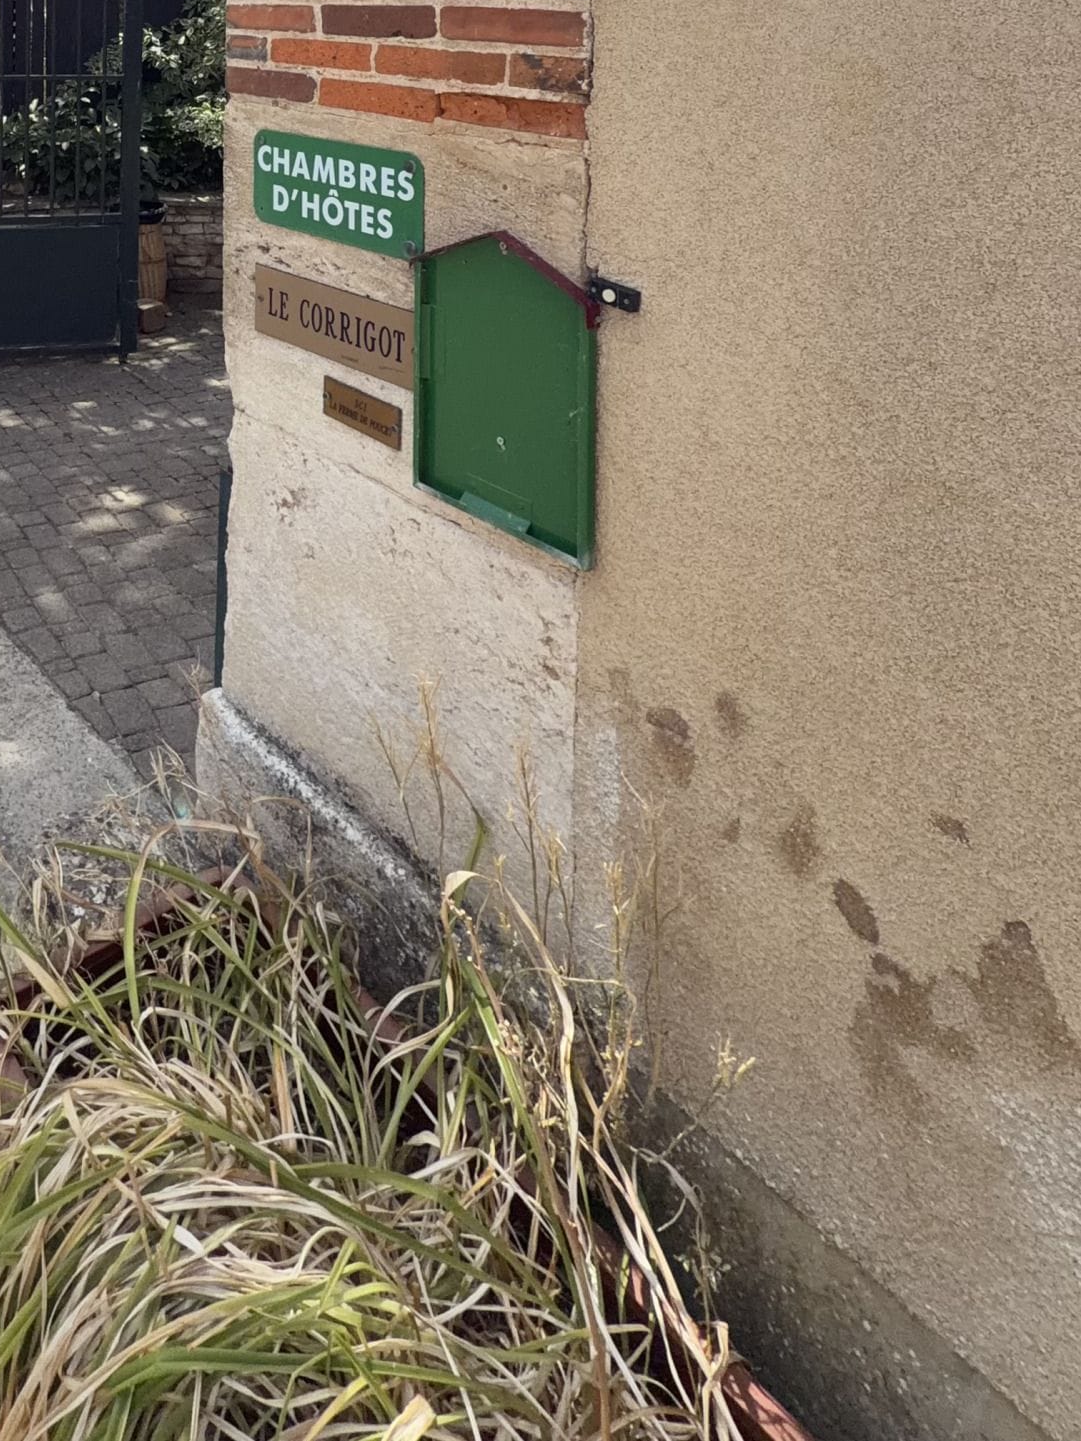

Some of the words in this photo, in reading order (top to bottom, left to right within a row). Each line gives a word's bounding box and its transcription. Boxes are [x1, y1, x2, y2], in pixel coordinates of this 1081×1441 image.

[257, 144, 416, 202] CHAMBRES
[272, 188, 394, 240] D'HÔTES
[267, 287, 290, 322] LE
[299, 298, 406, 364] CORRIGOT
